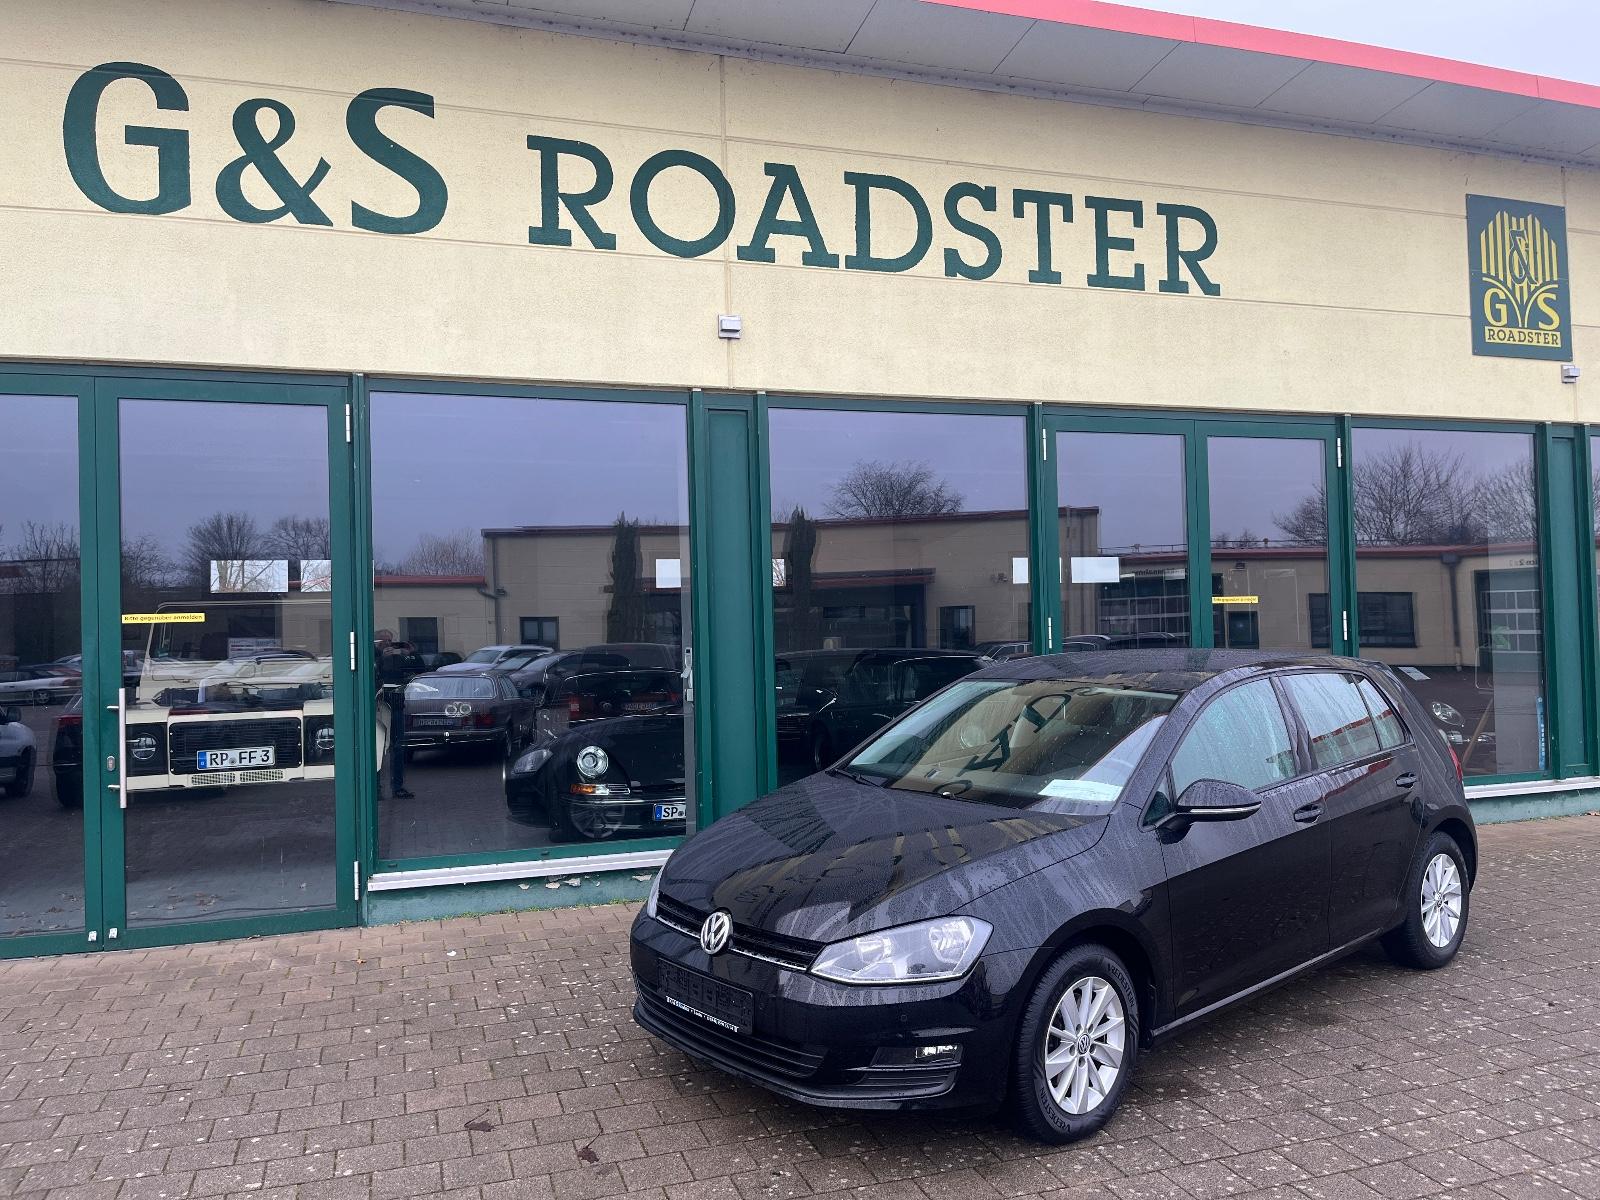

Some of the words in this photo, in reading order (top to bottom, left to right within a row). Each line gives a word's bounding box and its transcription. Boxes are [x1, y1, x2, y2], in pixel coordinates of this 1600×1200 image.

[63, 61, 449, 235] G&S
[526, 133, 1221, 297] ROADSTER
[1487, 328, 1559, 346] ROADSTER
[209, 752, 229, 766] RP
[239, 750, 258, 764] FF
[260, 749, 270, 763] 3
[662, 806, 678, 818] SP
